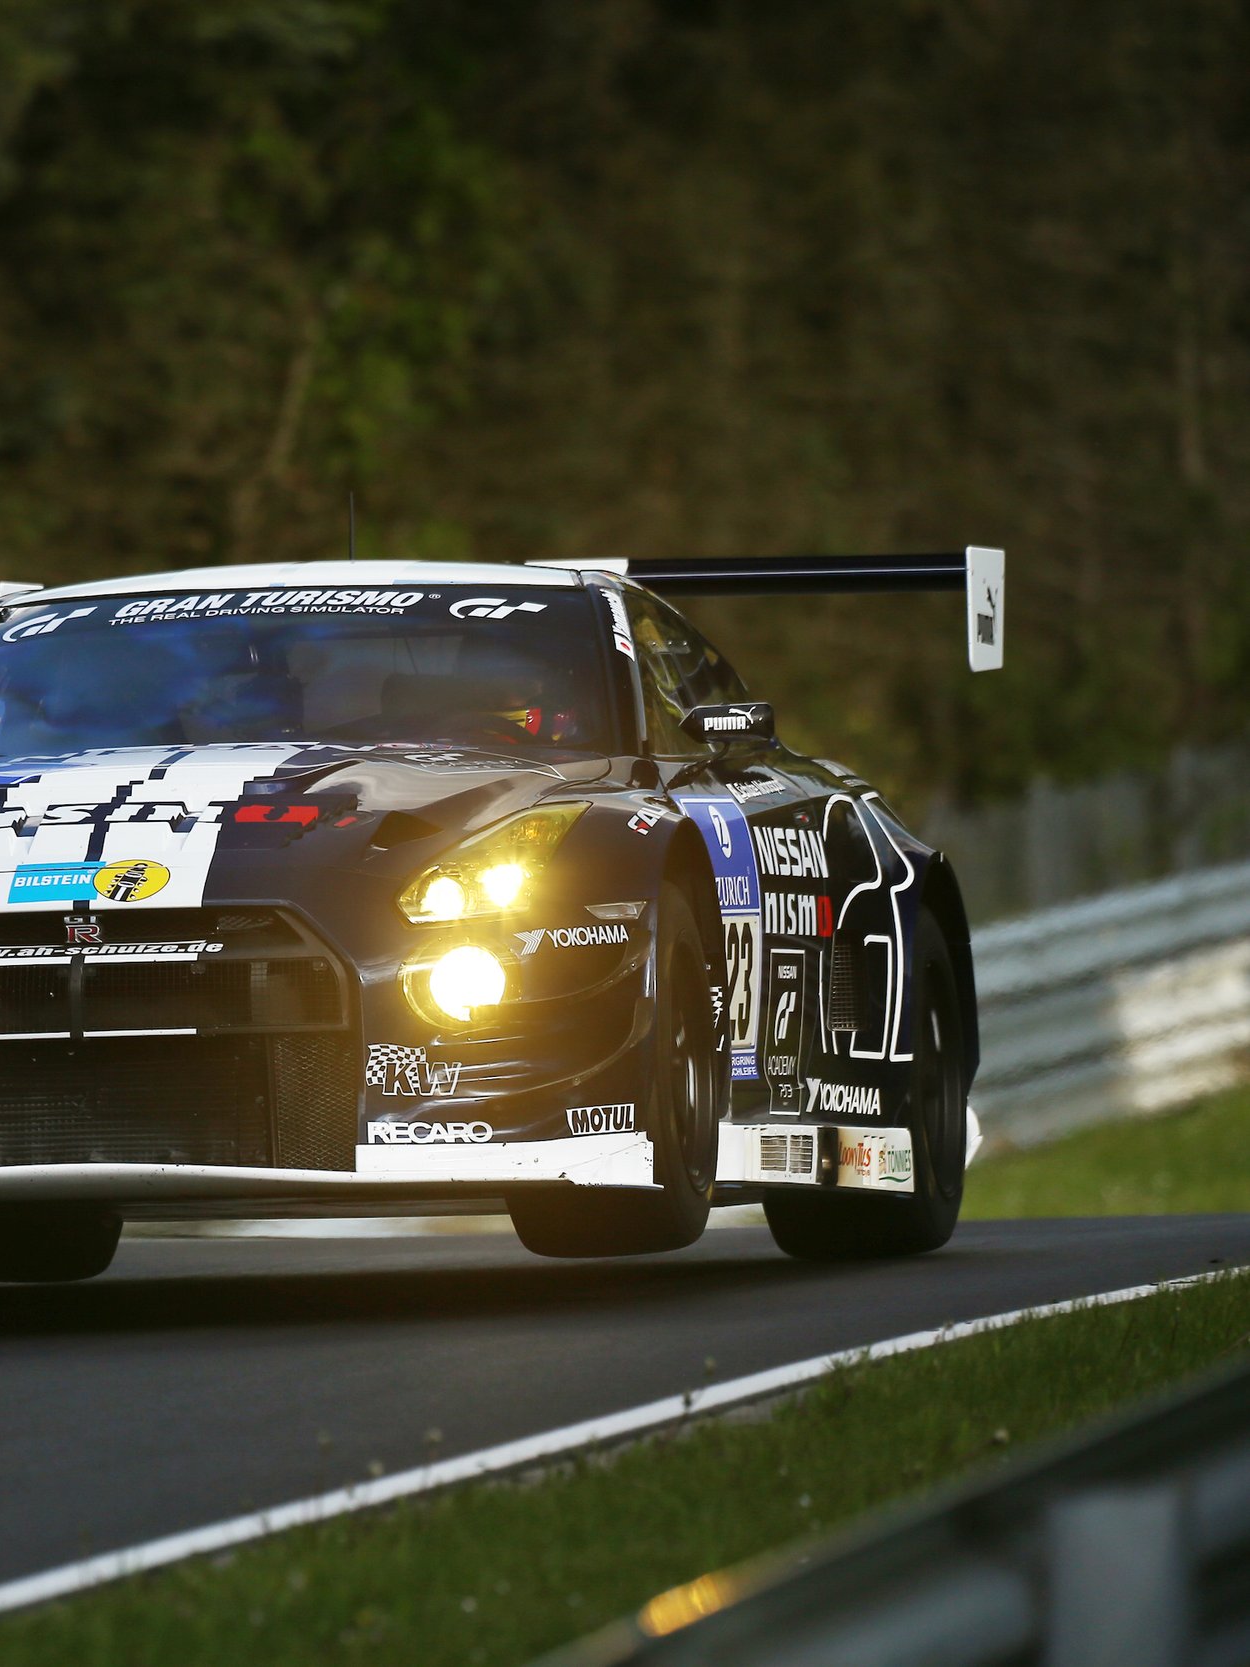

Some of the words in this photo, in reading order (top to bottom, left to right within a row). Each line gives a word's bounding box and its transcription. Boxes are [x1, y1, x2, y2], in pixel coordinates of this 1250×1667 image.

[108, 615, 145, 626] THE
[150, 611, 200, 622] REAL
[205, 606, 285, 617] DRIVING
[289, 605, 405, 615] SIMULATOR
[114, 594, 238, 617] GRAN
[238, 590, 424, 608] TURISMO
[704, 715, 750, 731] PUMA
[753, 826, 829, 878] NISSAN
[14, 873, 92, 888] BILSTEIN
[715, 876, 750, 906] ZURICH
[546, 924, 629, 948] YOKOHAMA
[723, 922, 754, 1041] 23
[778, 966, 797, 979] NISSAN
[731, 1055, 755, 1066] RGRING
[768, 1055, 797, 1076] ACADEMY
[381, 1062, 462, 1096] KW
[817, 1081, 881, 1116] YOKOHAMA
[571, 1105, 633, 1133] MOTUL
[367, 1121, 493, 1144] RECARO
